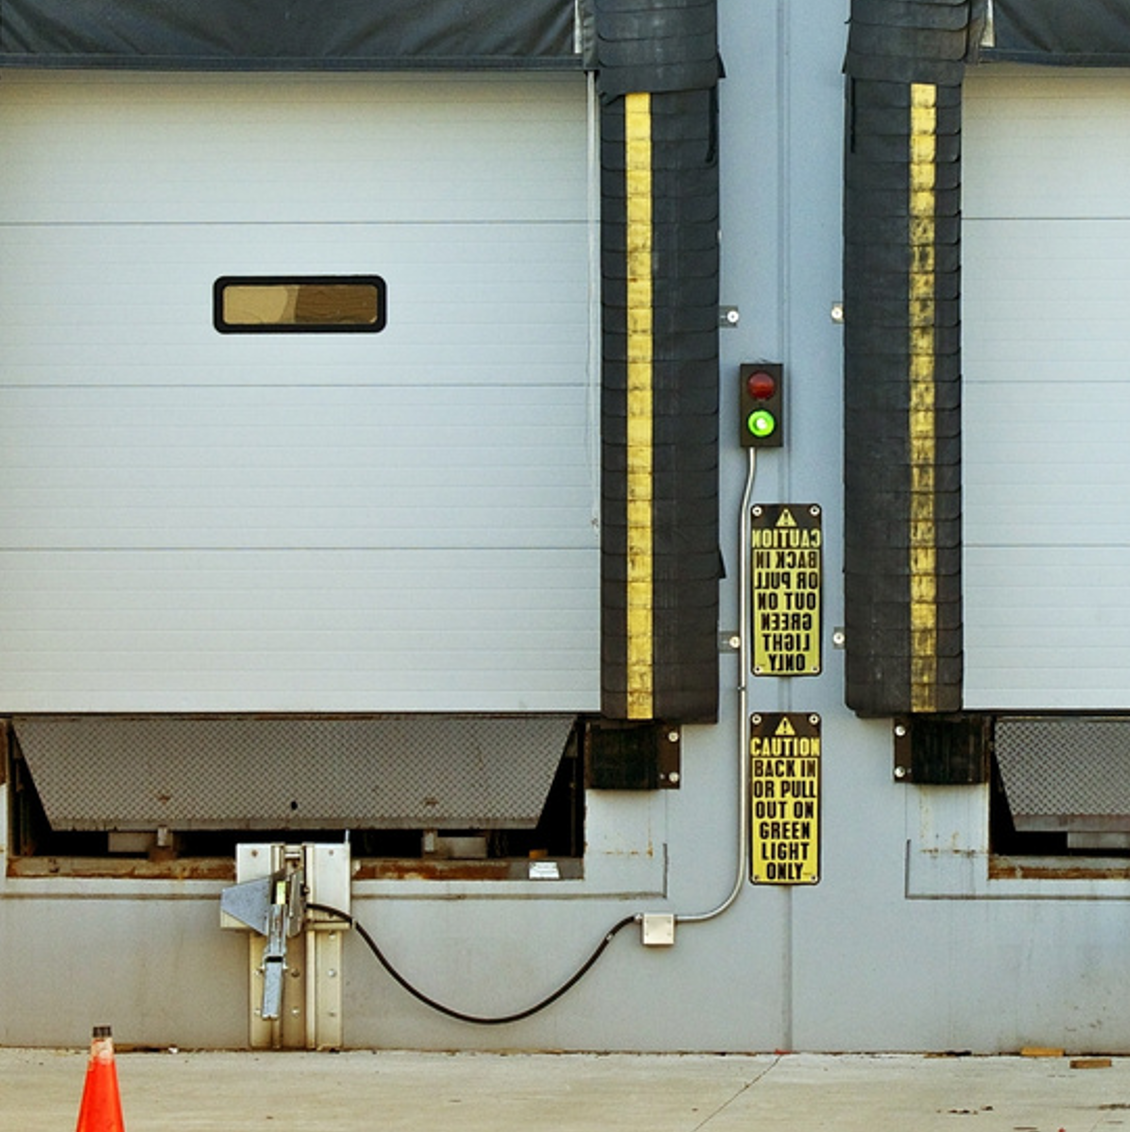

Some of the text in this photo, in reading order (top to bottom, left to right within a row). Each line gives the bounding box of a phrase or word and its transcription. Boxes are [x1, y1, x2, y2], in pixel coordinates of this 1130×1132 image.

[751, 737, 820, 756] CAUTION
[754, 760, 816, 777] BACK IN
[754, 780, 816, 798] OR PULL
[756, 801, 813, 819] OUT ON
[759, 821, 810, 839] GREEN
[762, 842, 809, 860] LIGHT
[767, 862, 803, 880] ONLY
